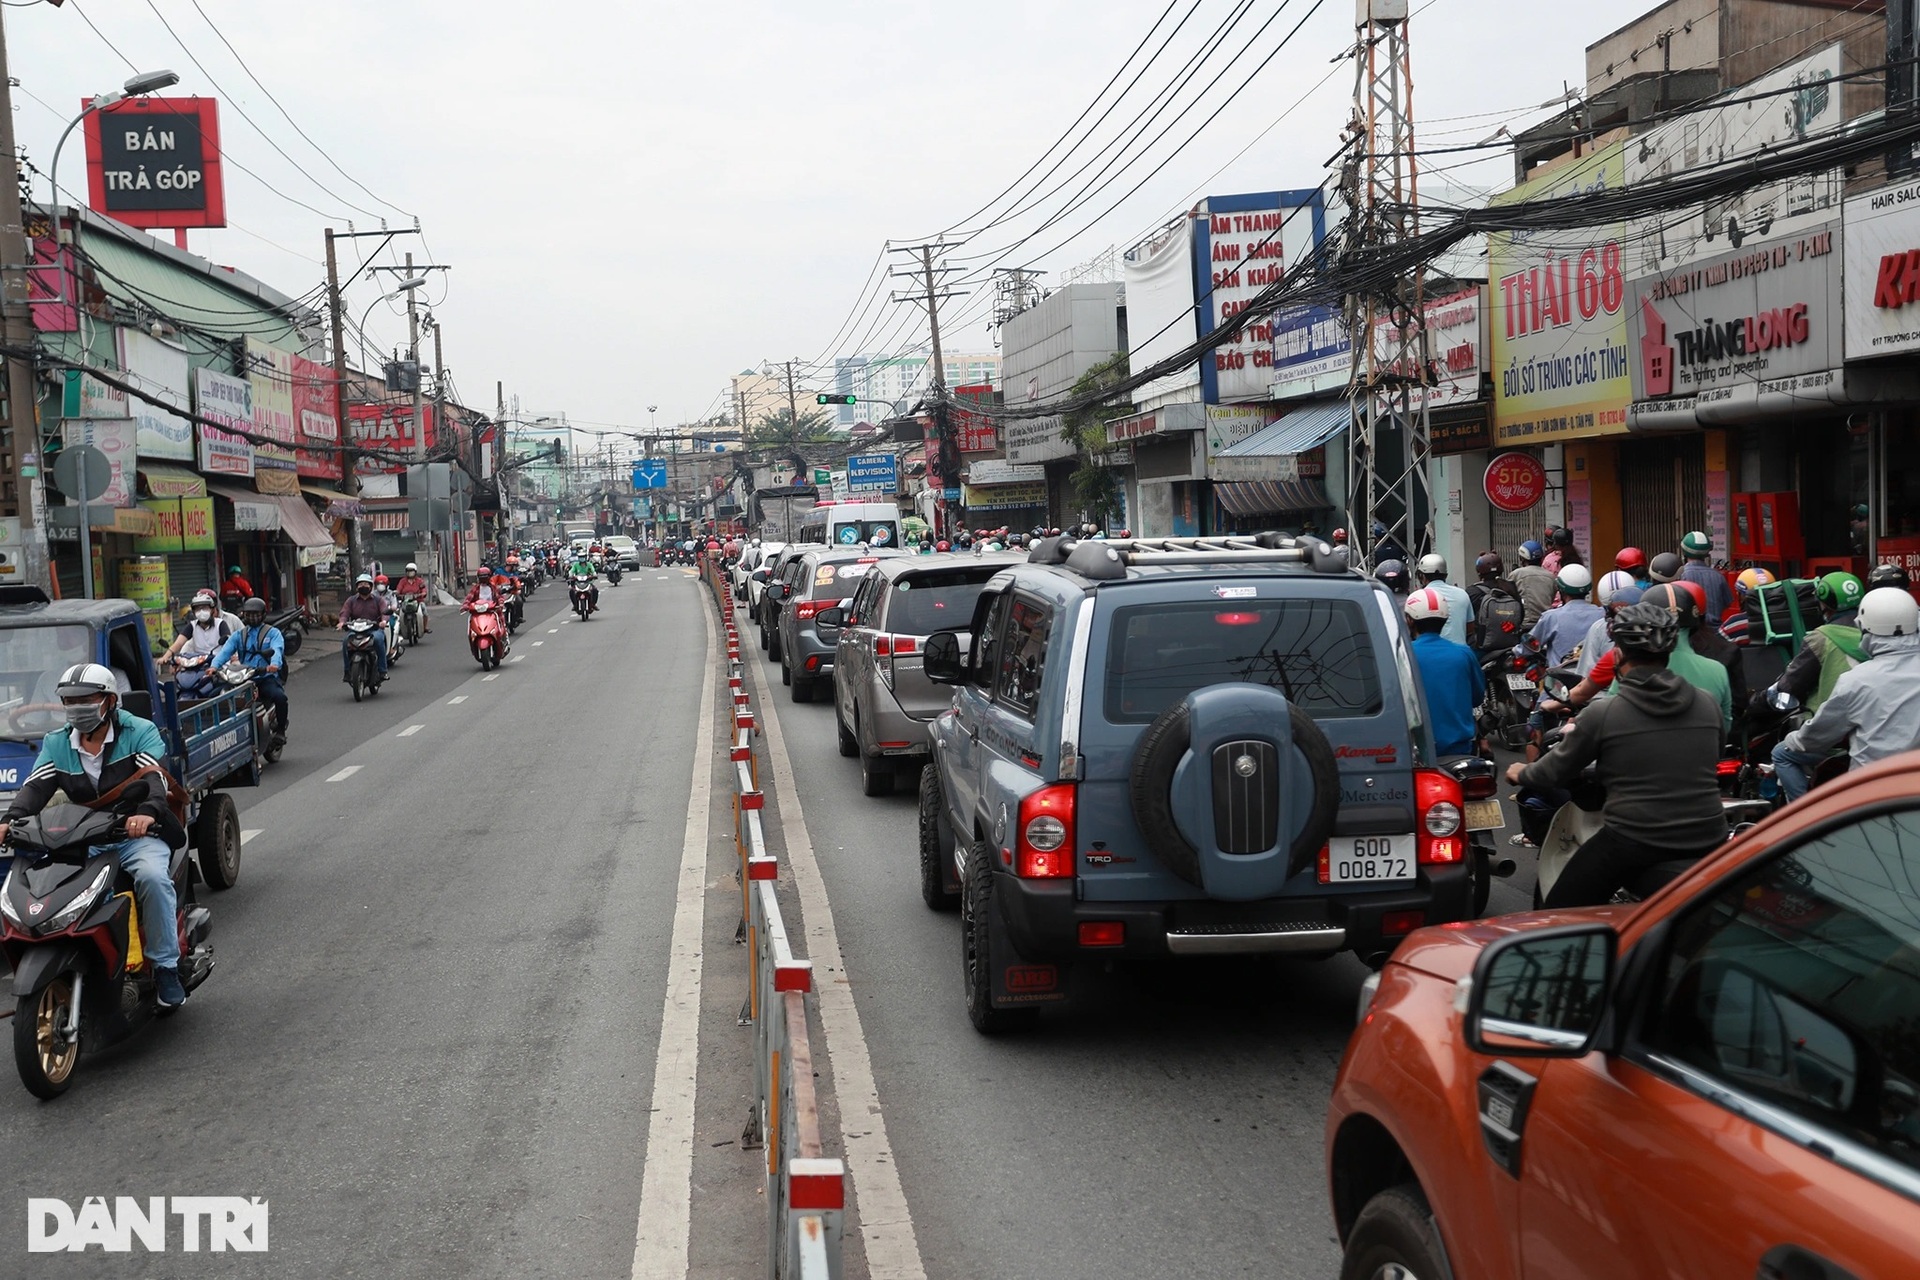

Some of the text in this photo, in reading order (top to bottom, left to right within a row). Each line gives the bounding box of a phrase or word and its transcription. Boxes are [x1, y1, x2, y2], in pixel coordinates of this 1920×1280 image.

[125, 125, 175, 150] BÁN
[104, 164, 201, 190] TRẢ GÓP
[1871, 193, 1895, 210] HAIR
[1210, 212, 1282, 234] ÂM THANH
[1212, 238, 1283, 261] ÁNH SÁNG
[1212, 262, 1284, 288] SÂN KHẤU
[1500, 237, 1625, 342] THÁI 68
[1872, 337, 1883, 346] 617
[1884, 332, 1911, 344] TRƯỜNG
[1216, 348, 1245, 370] BÁO
[1503, 338, 1628, 398] ĐỔI SỐ TRÚNG CÁC TỈNH
[1680, 371, 1692, 384] Fire
[1718, 363, 1731, 377] and
[1733, 357, 1769, 380] prevention
[1206, 405, 1231, 420] Trạm
[1232, 404, 1252, 417] Bảo
[1229, 421, 1248, 435] ĐIỆN
[856, 457, 887, 465] CAMERA
[851, 467, 894, 477] KBVISION
[1344, 788, 1409, 802] Mercedes
[1353, 838, 1391, 857] 60D
[1086, 855, 1112, 863] TRD
[1339, 859, 1407, 879] 008.72
